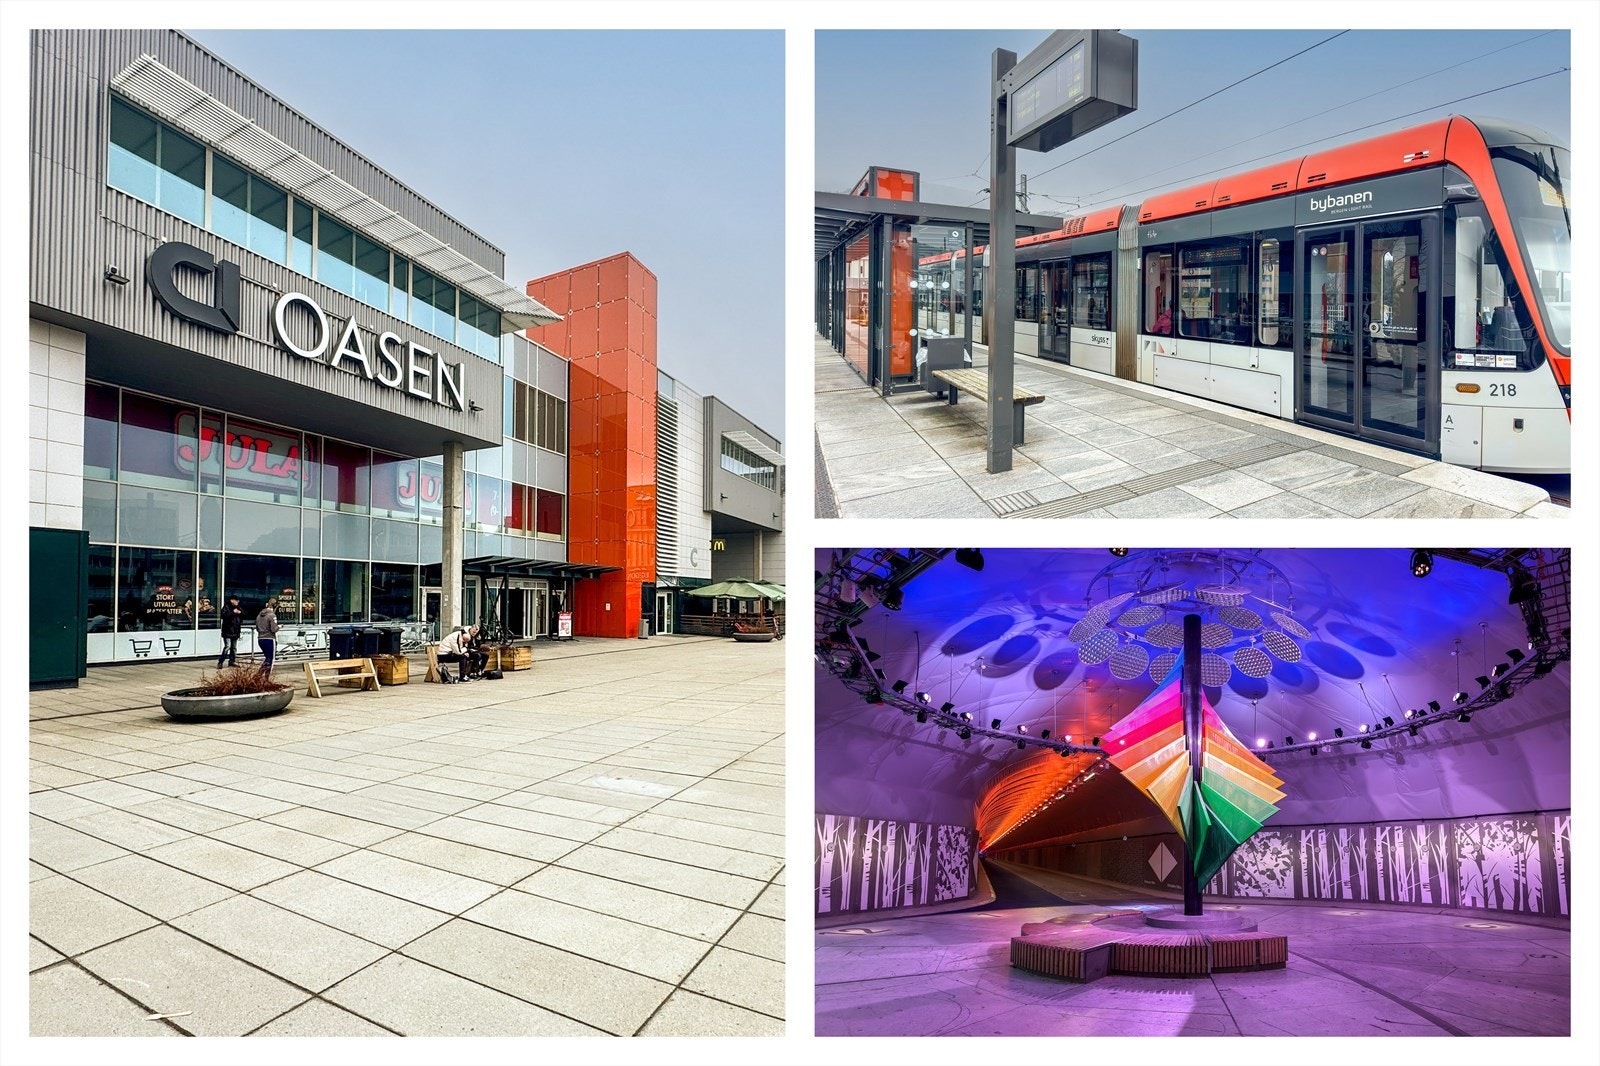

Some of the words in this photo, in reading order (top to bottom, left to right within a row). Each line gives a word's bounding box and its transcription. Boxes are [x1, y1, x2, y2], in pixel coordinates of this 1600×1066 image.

[1310, 191, 1373, 213] bybanen
[272, 291, 465, 413] OASEN
[1489, 383, 1517, 397] 218
[1445, 414, 1454, 424] A
[179, 426, 309, 481] JULA
